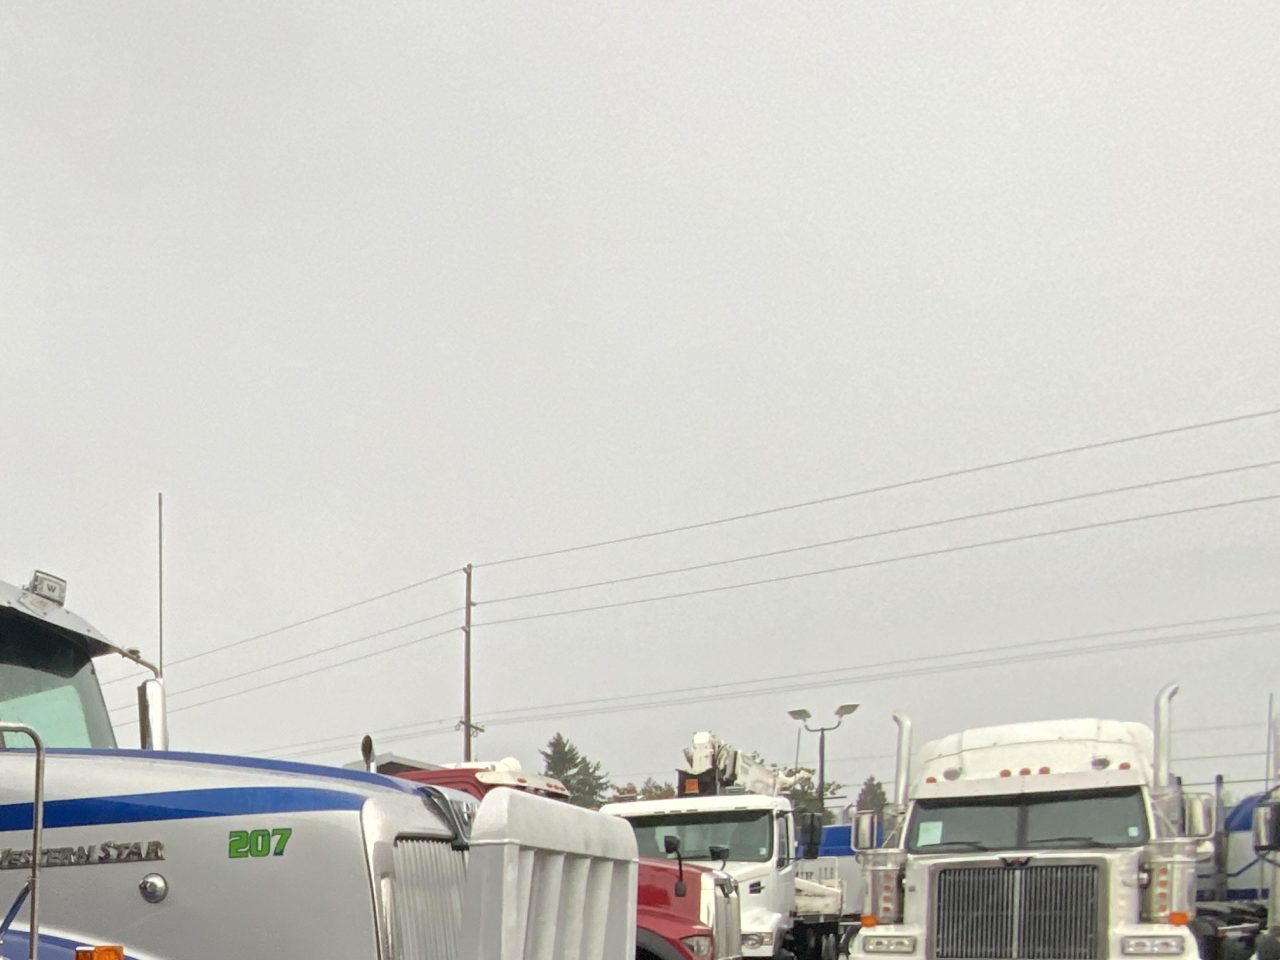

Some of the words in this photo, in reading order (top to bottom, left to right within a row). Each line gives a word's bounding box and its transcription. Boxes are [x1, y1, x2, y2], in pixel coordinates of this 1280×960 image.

[47, 583, 57, 593] W
[98, 841, 165, 861] STAR
[228, 827, 292, 858] 207
